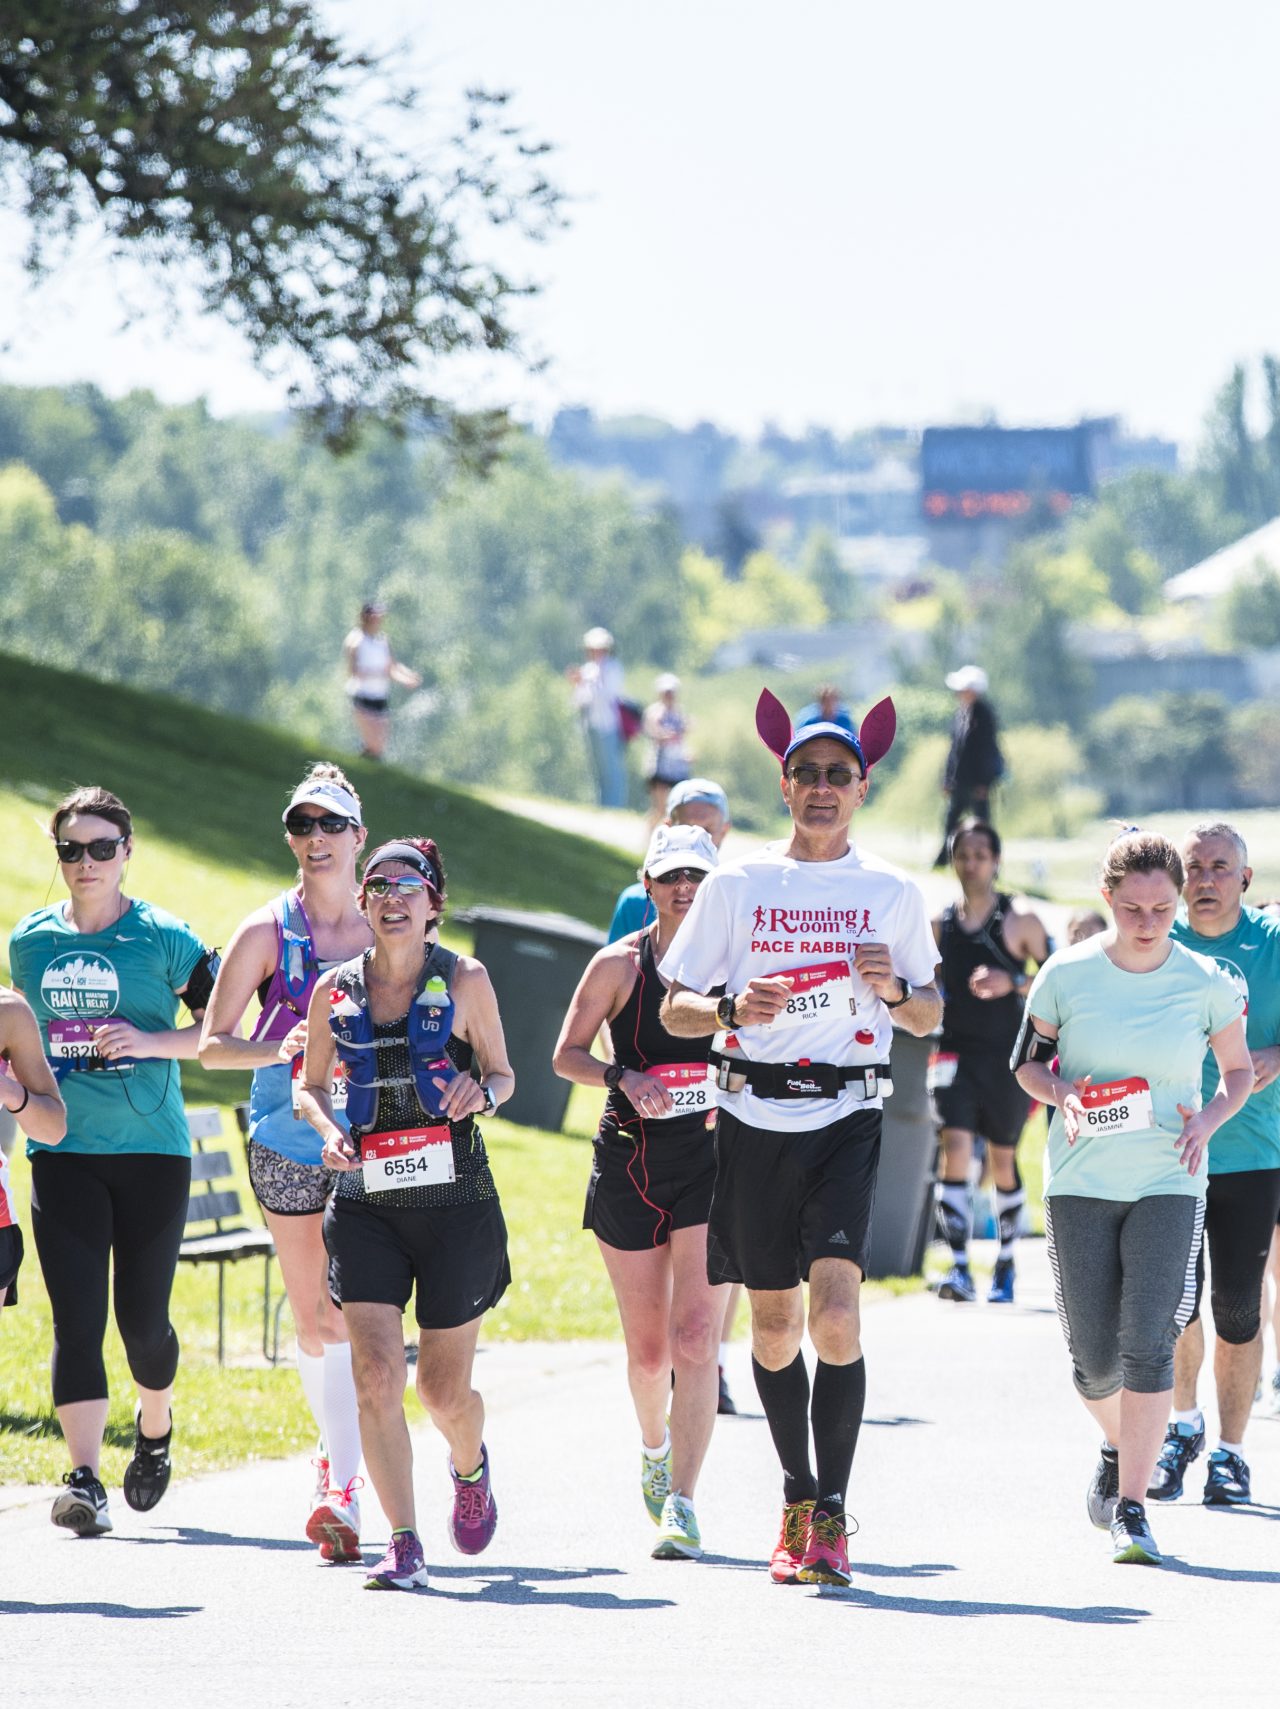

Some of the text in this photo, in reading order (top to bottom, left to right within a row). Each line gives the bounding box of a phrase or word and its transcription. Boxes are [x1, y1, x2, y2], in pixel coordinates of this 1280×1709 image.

[768, 906, 858, 933] Running
[751, 941, 794, 953] PACE
[50, 990, 78, 1008] RAN
[85, 999, 109, 1009] RELAY
[786, 992, 831, 1014] 8312
[802, 1012, 818, 1020] RICK
[1087, 1106, 1129, 1125] 6688
[1096, 1123, 1124, 1132] JASMINE
[384, 1156, 428, 1176] 6554
